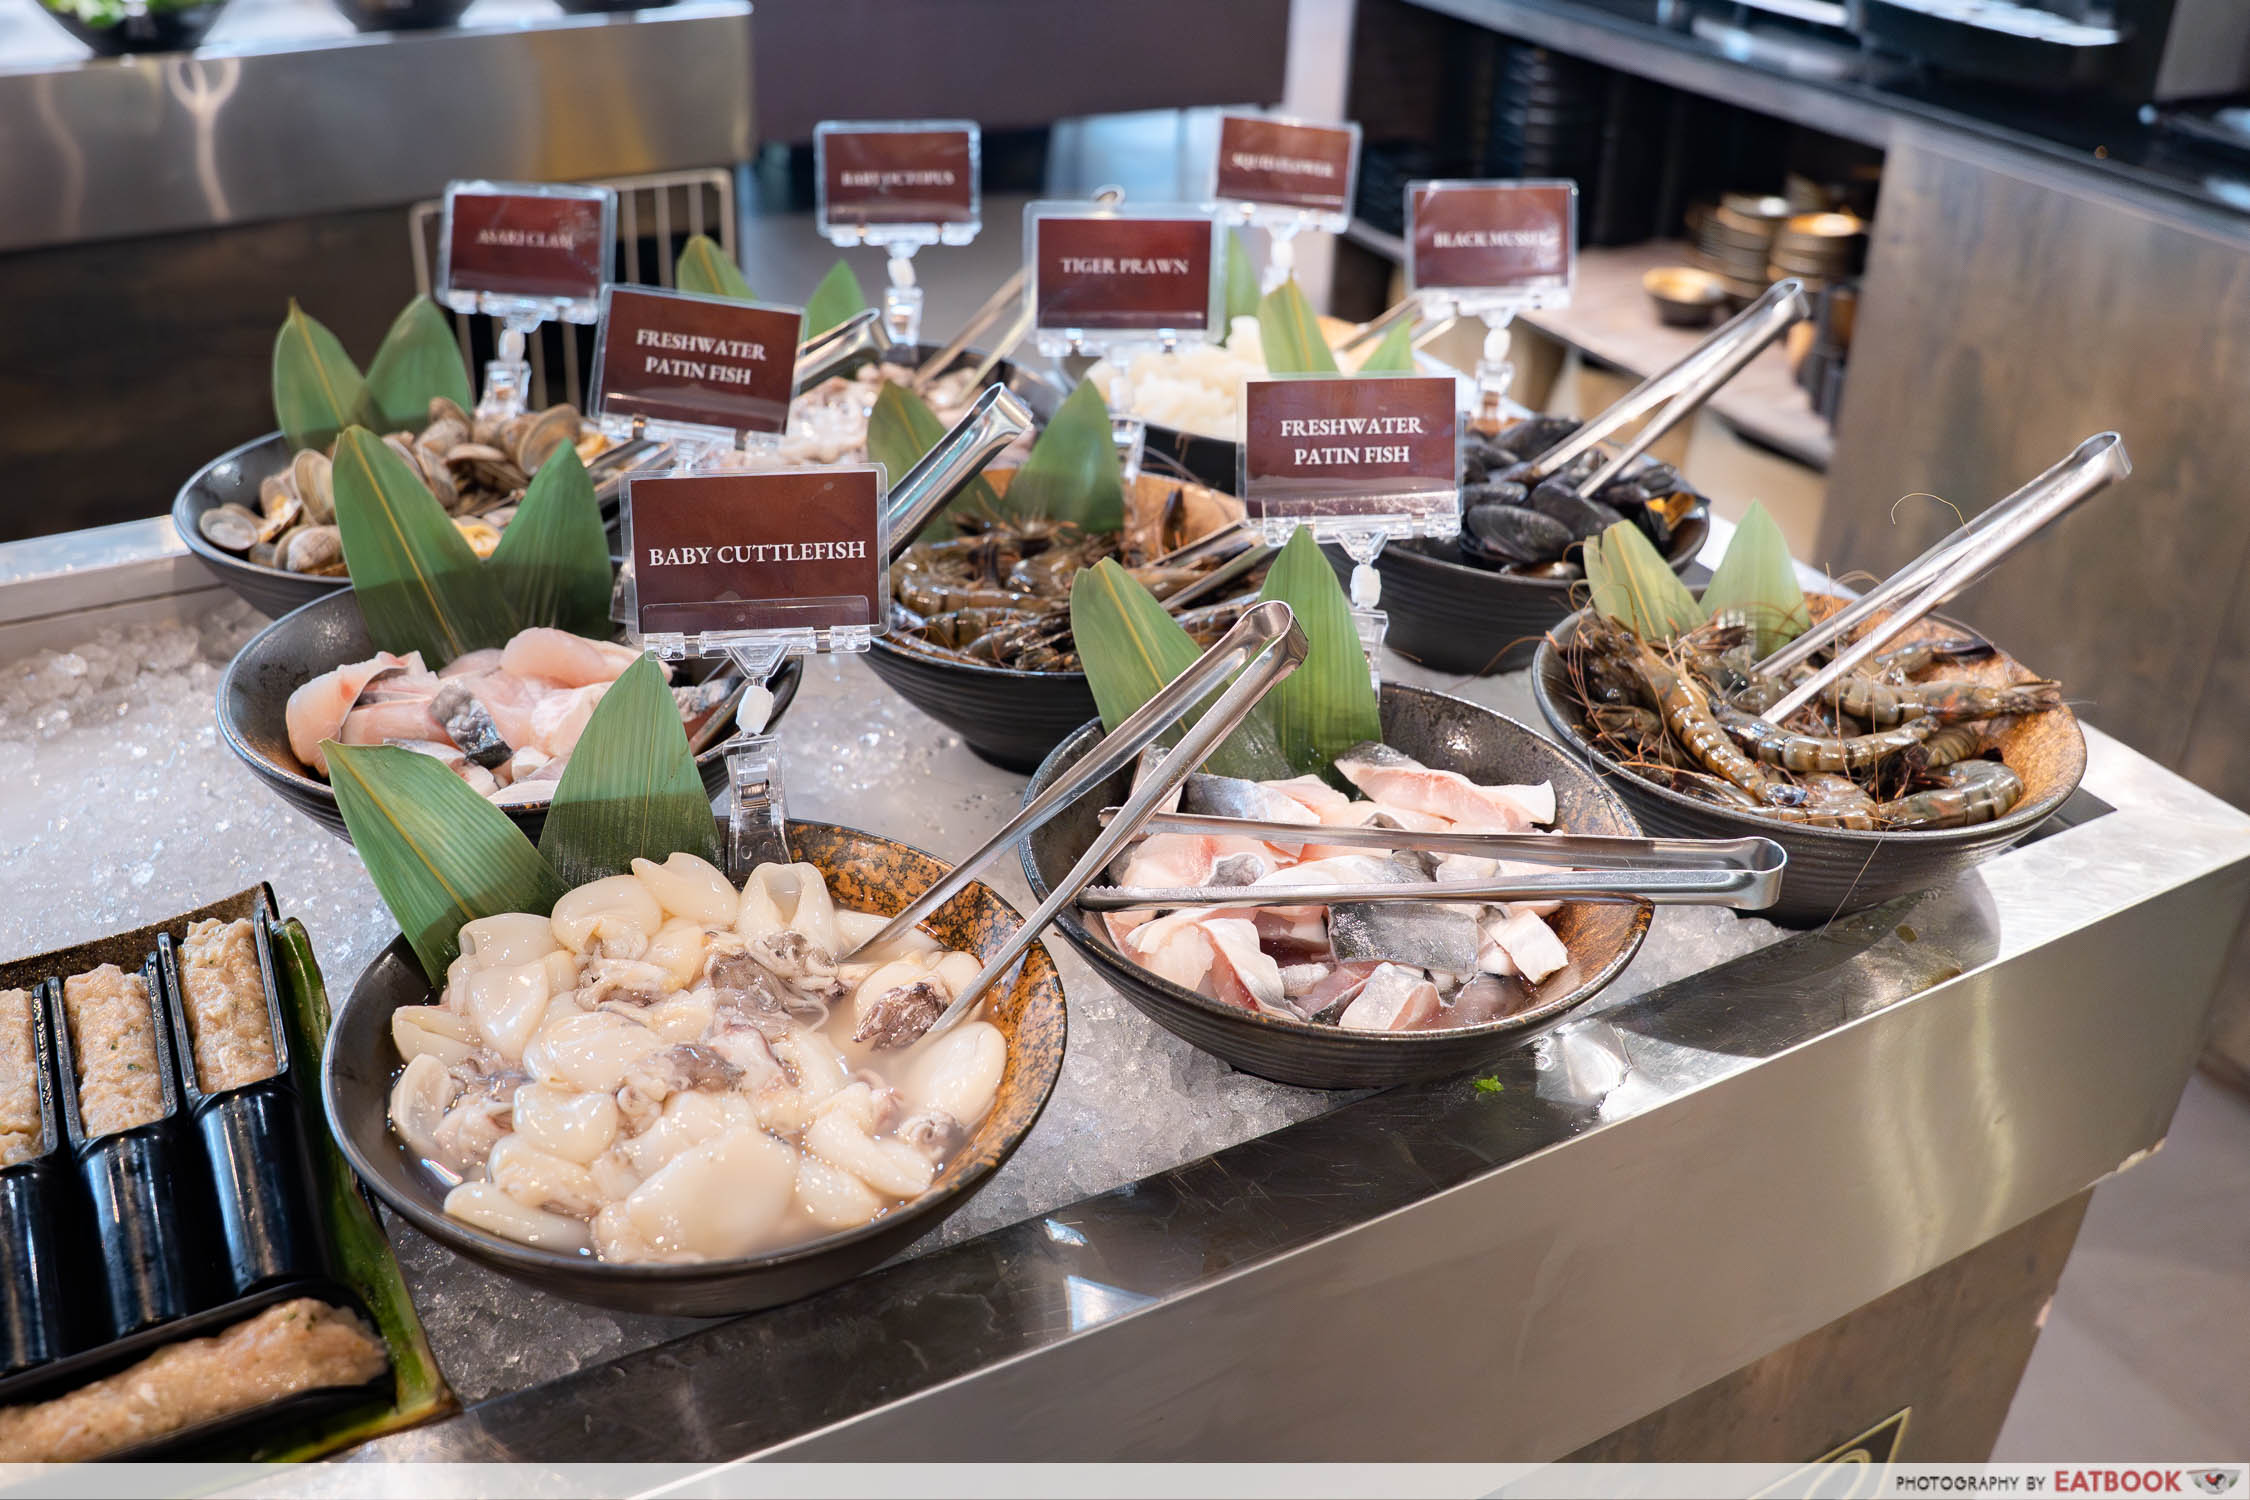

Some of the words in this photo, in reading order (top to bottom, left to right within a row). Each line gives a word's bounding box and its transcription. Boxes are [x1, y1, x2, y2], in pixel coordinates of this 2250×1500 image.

[1433, 231, 1486, 248] BLACK
[1060, 257, 1116, 273] TIGER
[1120, 257, 1188, 273] PRAWN
[636, 328, 766, 361] FRESHWATER
[645, 356, 706, 379] PATIN
[709, 364, 751, 385] FISH
[1280, 416, 1424, 437] FRESHWATER
[1294, 447, 1360, 465] PATIN
[1364, 445, 1410, 463] FISH
[649, 546, 712, 566] BABY
[717, 540, 866, 564] CUTTLEFISH
